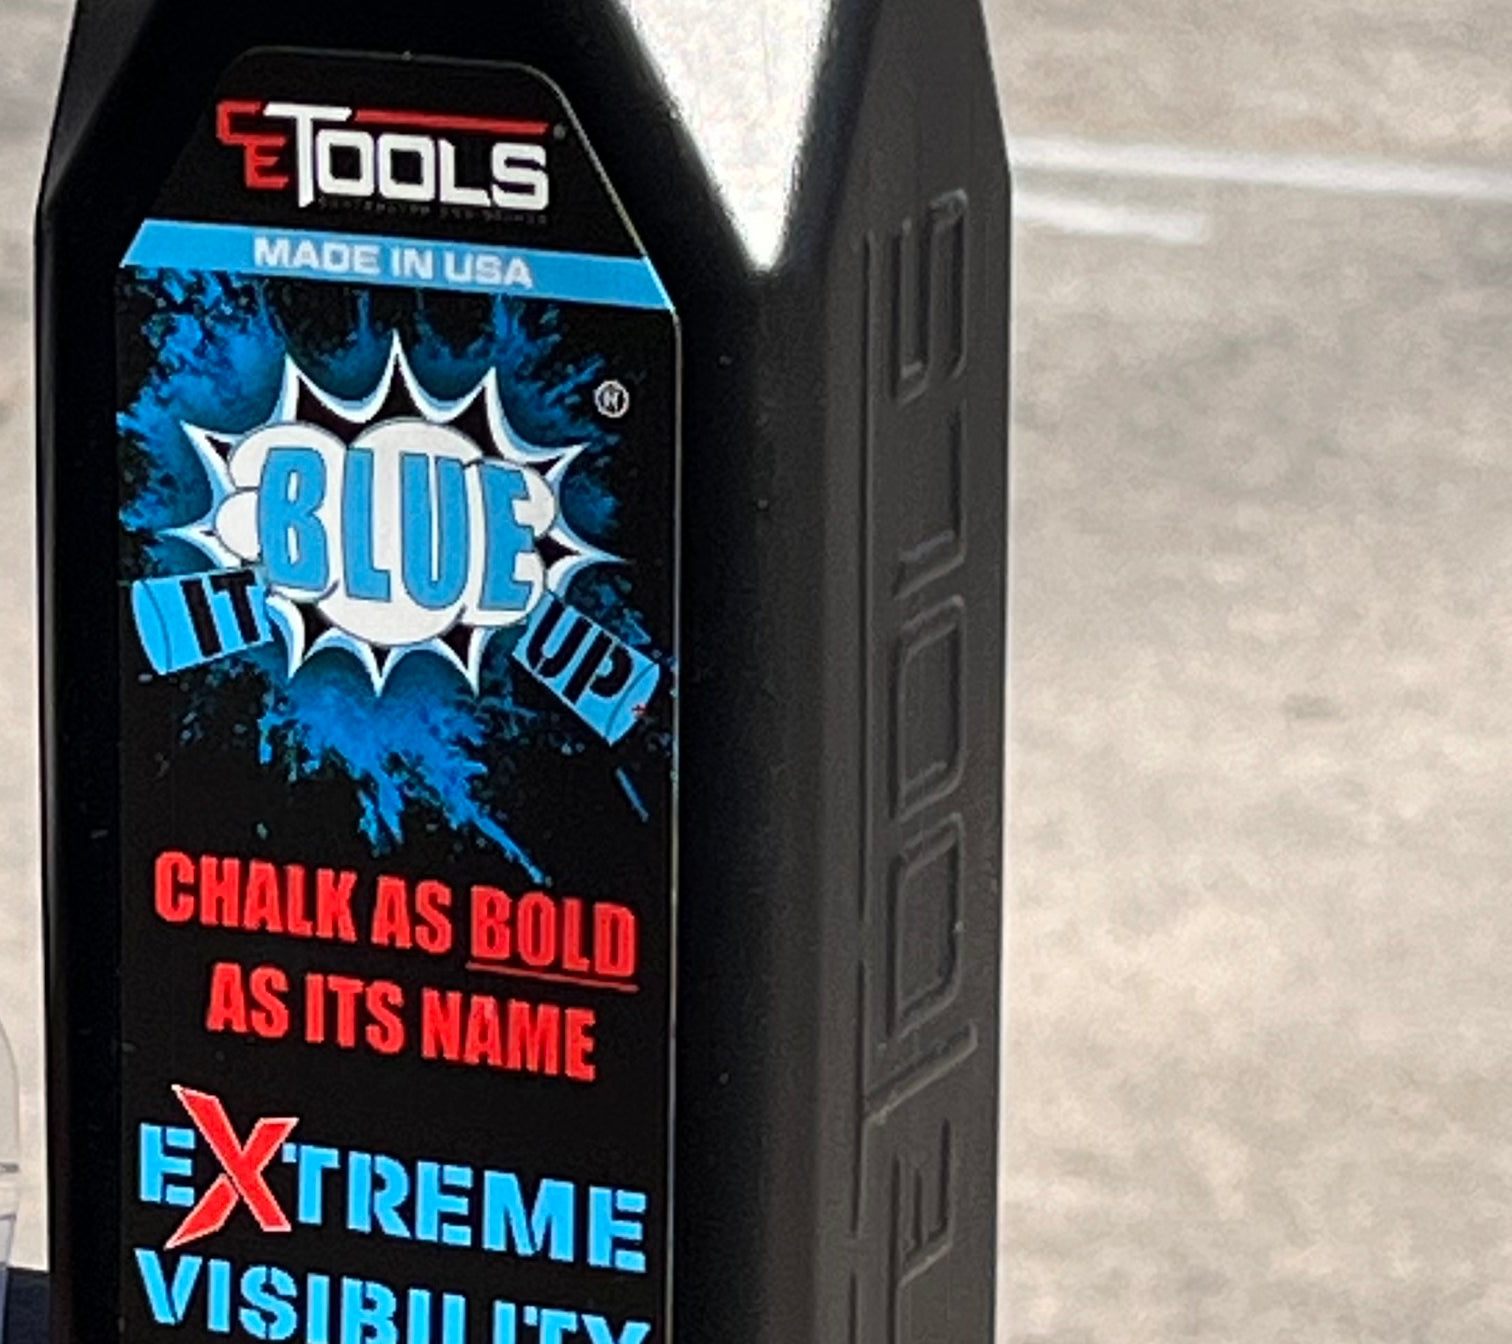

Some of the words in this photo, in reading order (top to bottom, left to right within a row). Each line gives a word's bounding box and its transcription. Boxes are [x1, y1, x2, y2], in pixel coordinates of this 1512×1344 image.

[254, 236, 381, 275] MADE
[393, 246, 433, 280] IN
[443, 253, 533, 288] USA
[259, 447, 535, 611] BLUE
[180, 568, 261, 657] IT
[153, 851, 357, 942] CHALK
[371, 876, 452, 954] AS
[469, 884, 636, 977] BOLD
[206, 962, 289, 1038] AS
[305, 973, 405, 1053] ITS
[421, 986, 597, 1082] NAME
[140, 1084, 646, 1273] EXTREME
